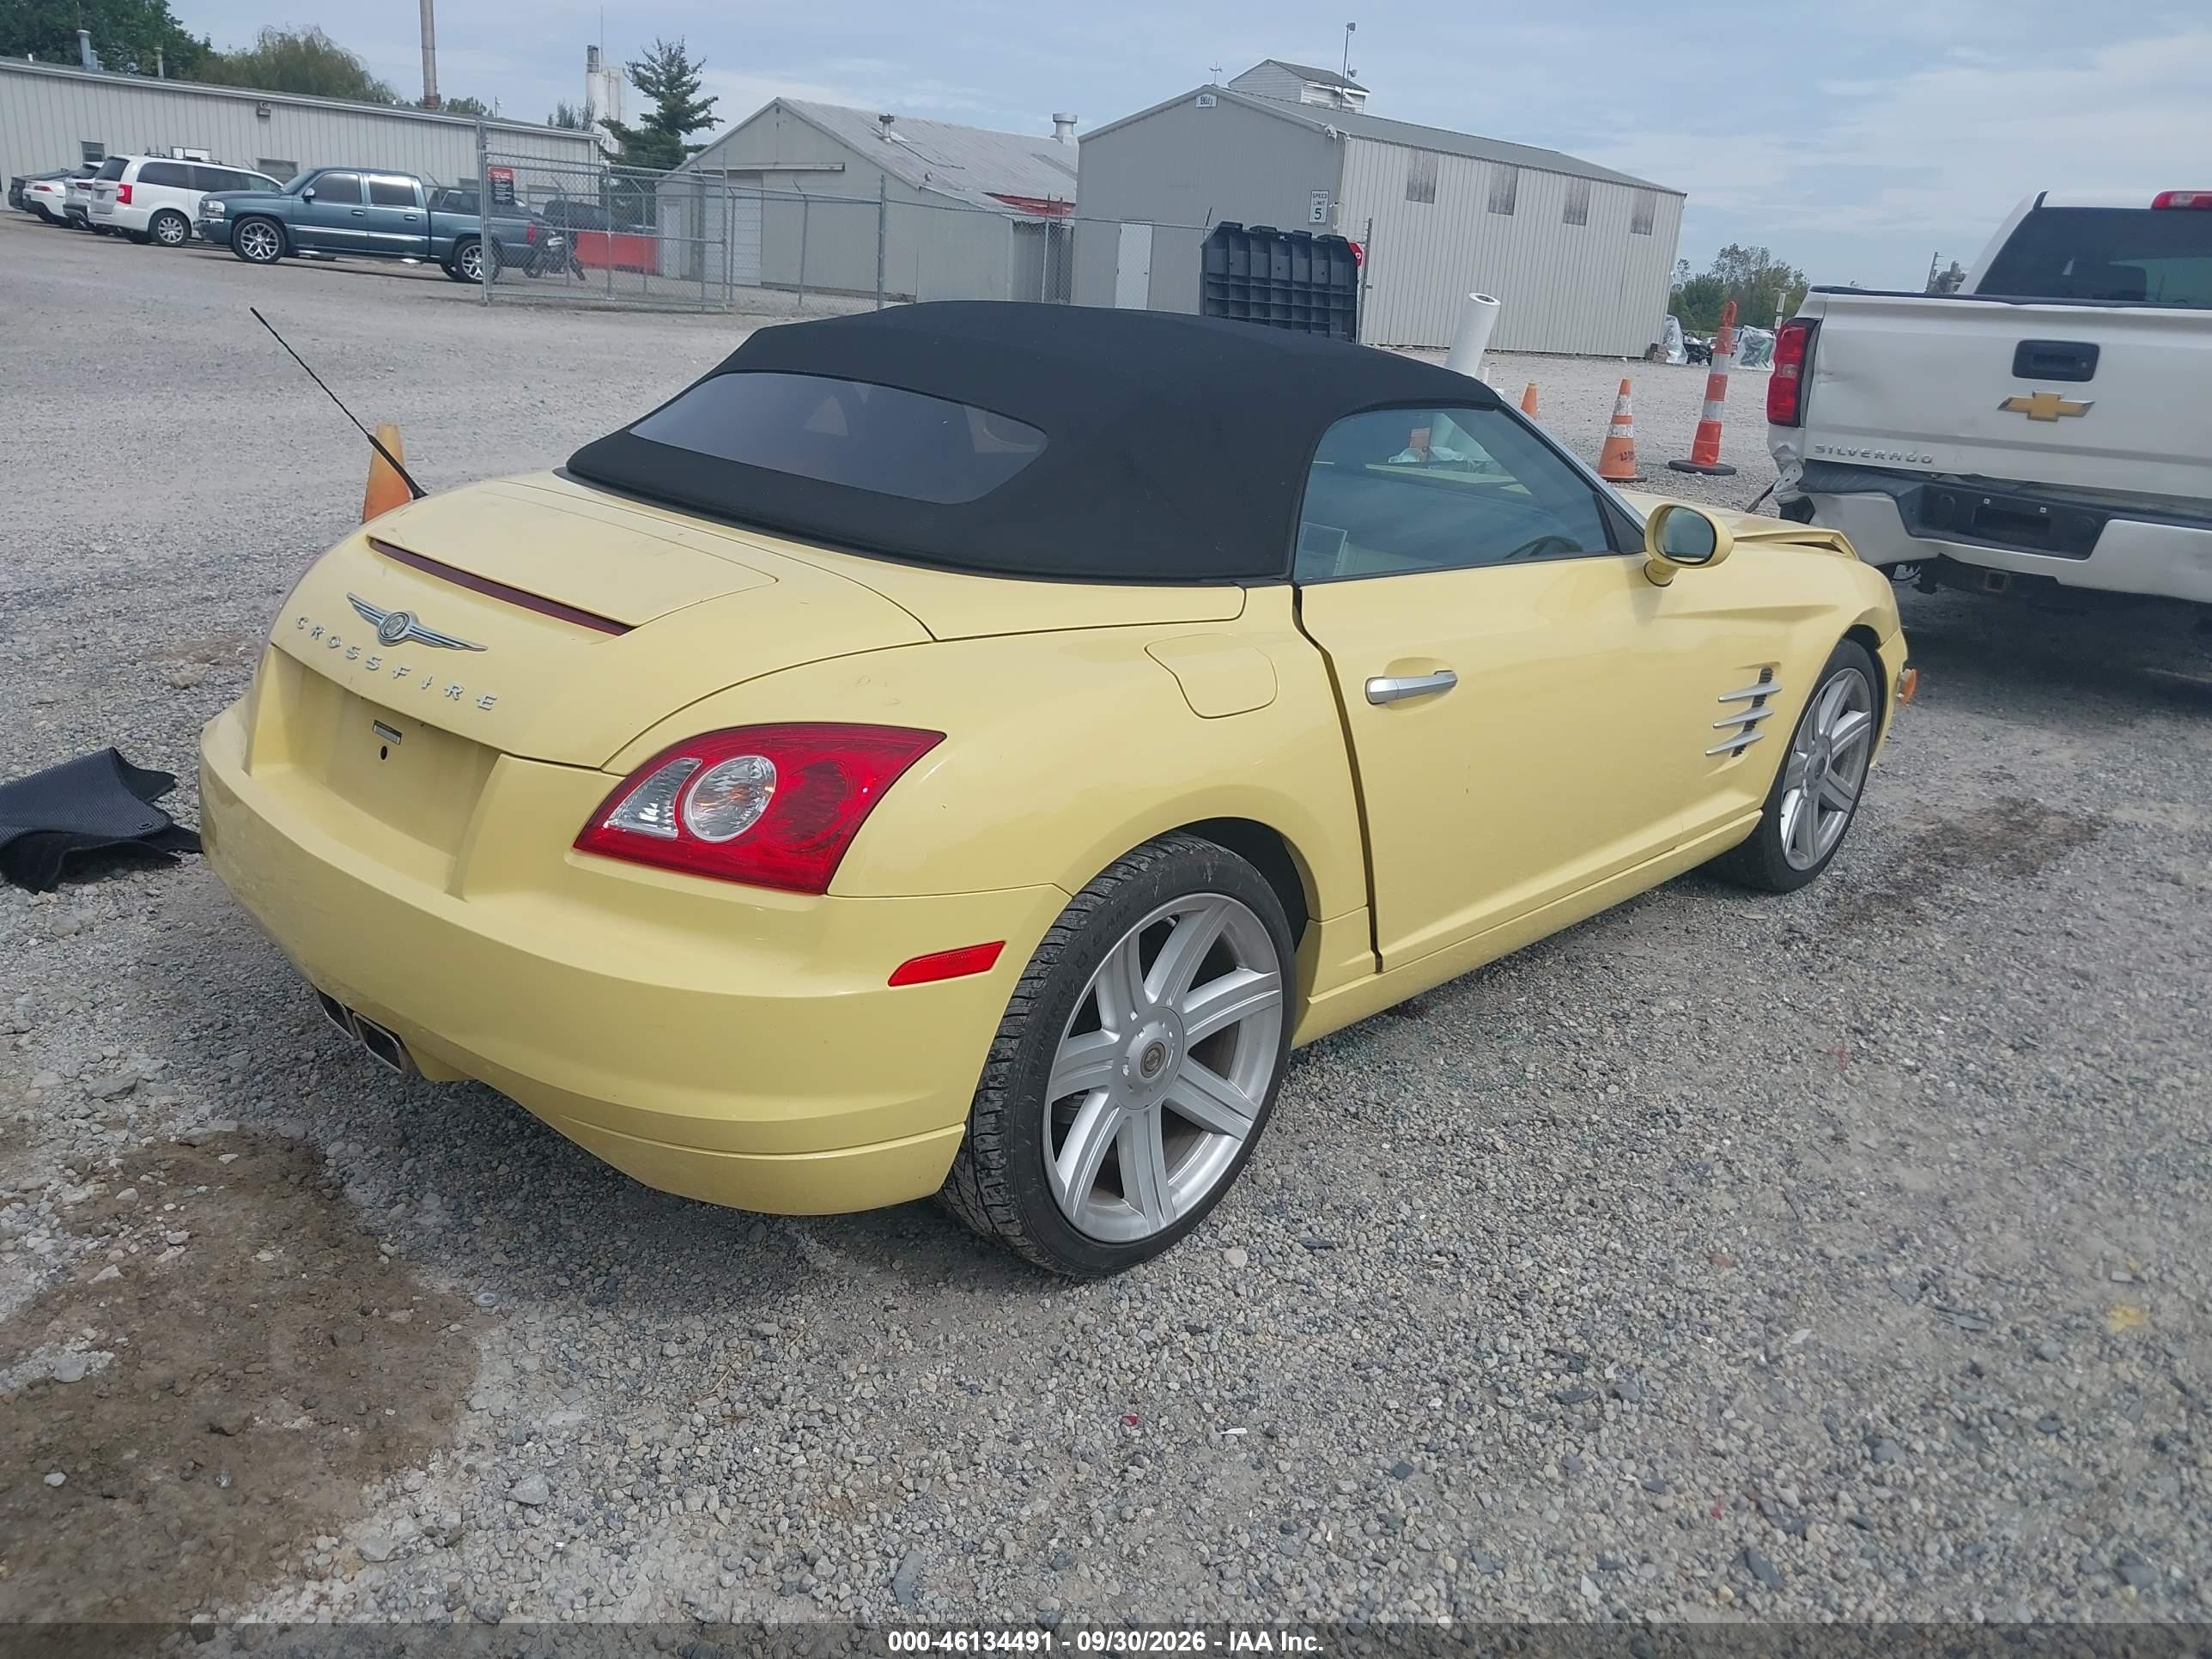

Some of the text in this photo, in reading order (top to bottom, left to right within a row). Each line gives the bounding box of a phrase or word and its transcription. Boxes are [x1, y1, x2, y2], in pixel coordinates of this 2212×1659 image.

[1315, 208, 1322, 220] 5
[1814, 443, 1934, 465] SILVERADO
[296, 617, 497, 710] CROSSFIRE
